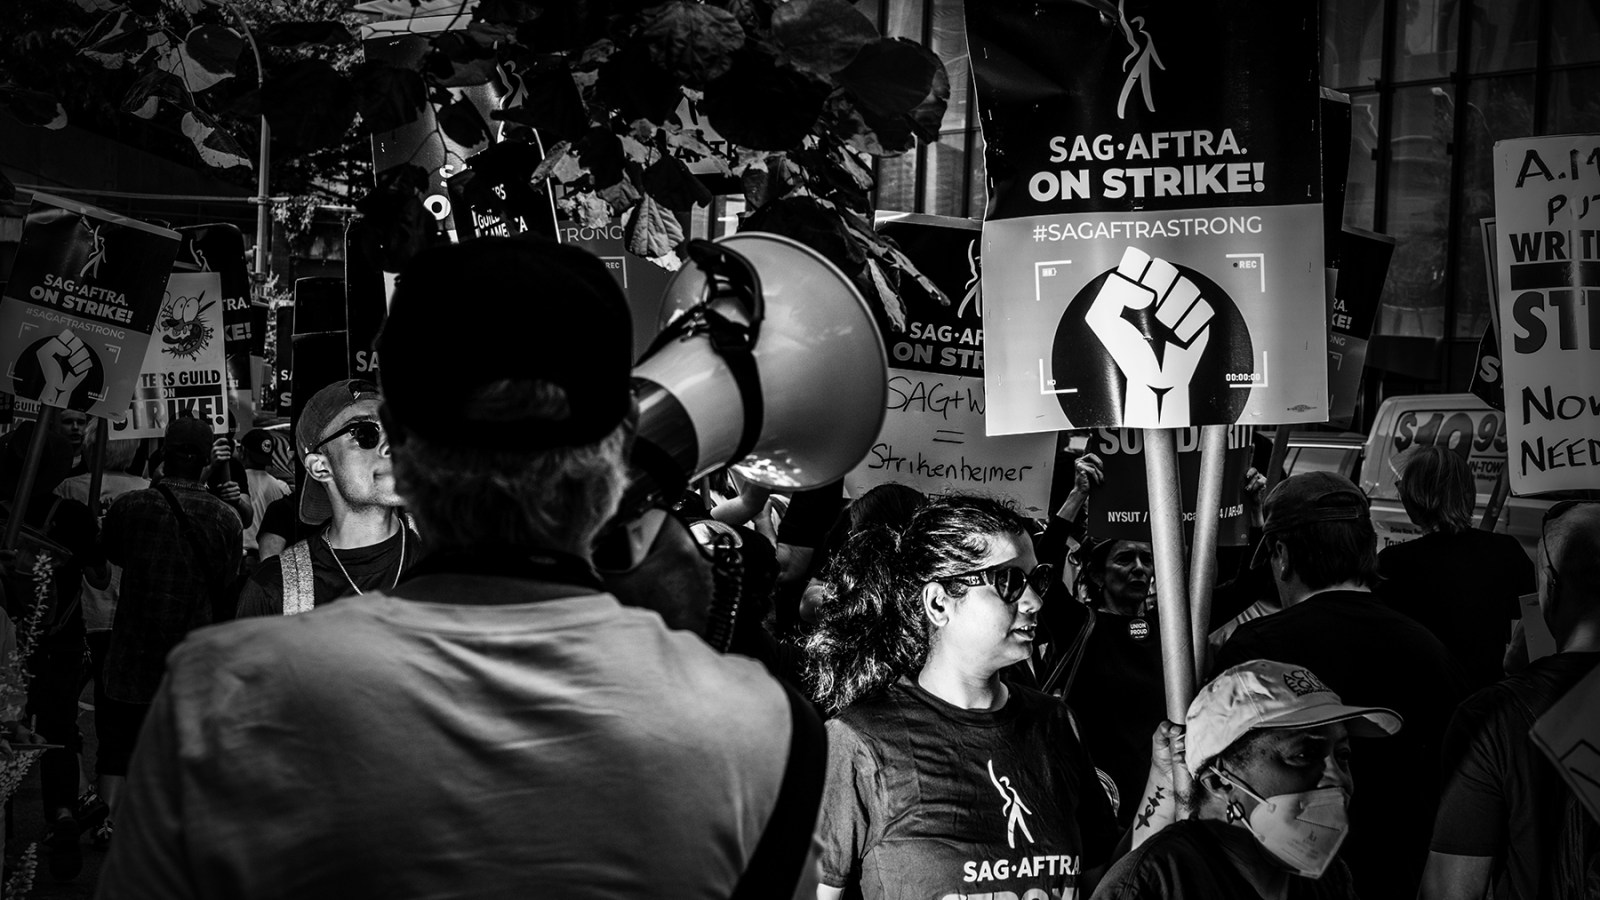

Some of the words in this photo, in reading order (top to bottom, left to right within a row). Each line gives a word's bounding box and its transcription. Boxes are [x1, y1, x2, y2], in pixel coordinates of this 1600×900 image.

[1028, 169, 1091, 202] ON
[1102, 162, 1265, 198] STRIKE!
[1032, 216, 1263, 242] #SAGAFTRASTRONG
[1239, 260, 1257, 269] REC
[29, 284, 60, 306] ON
[62, 293, 134, 325] STRIKE!
[25, 307, 126, 341] #SAGAFTRASTRONG
[892, 342, 934, 365] ON
[178, 369, 221, 386] GUILD
[868, 443, 1033, 482] Strikenheimer
[1107, 511, 1141, 523] NYSUT
